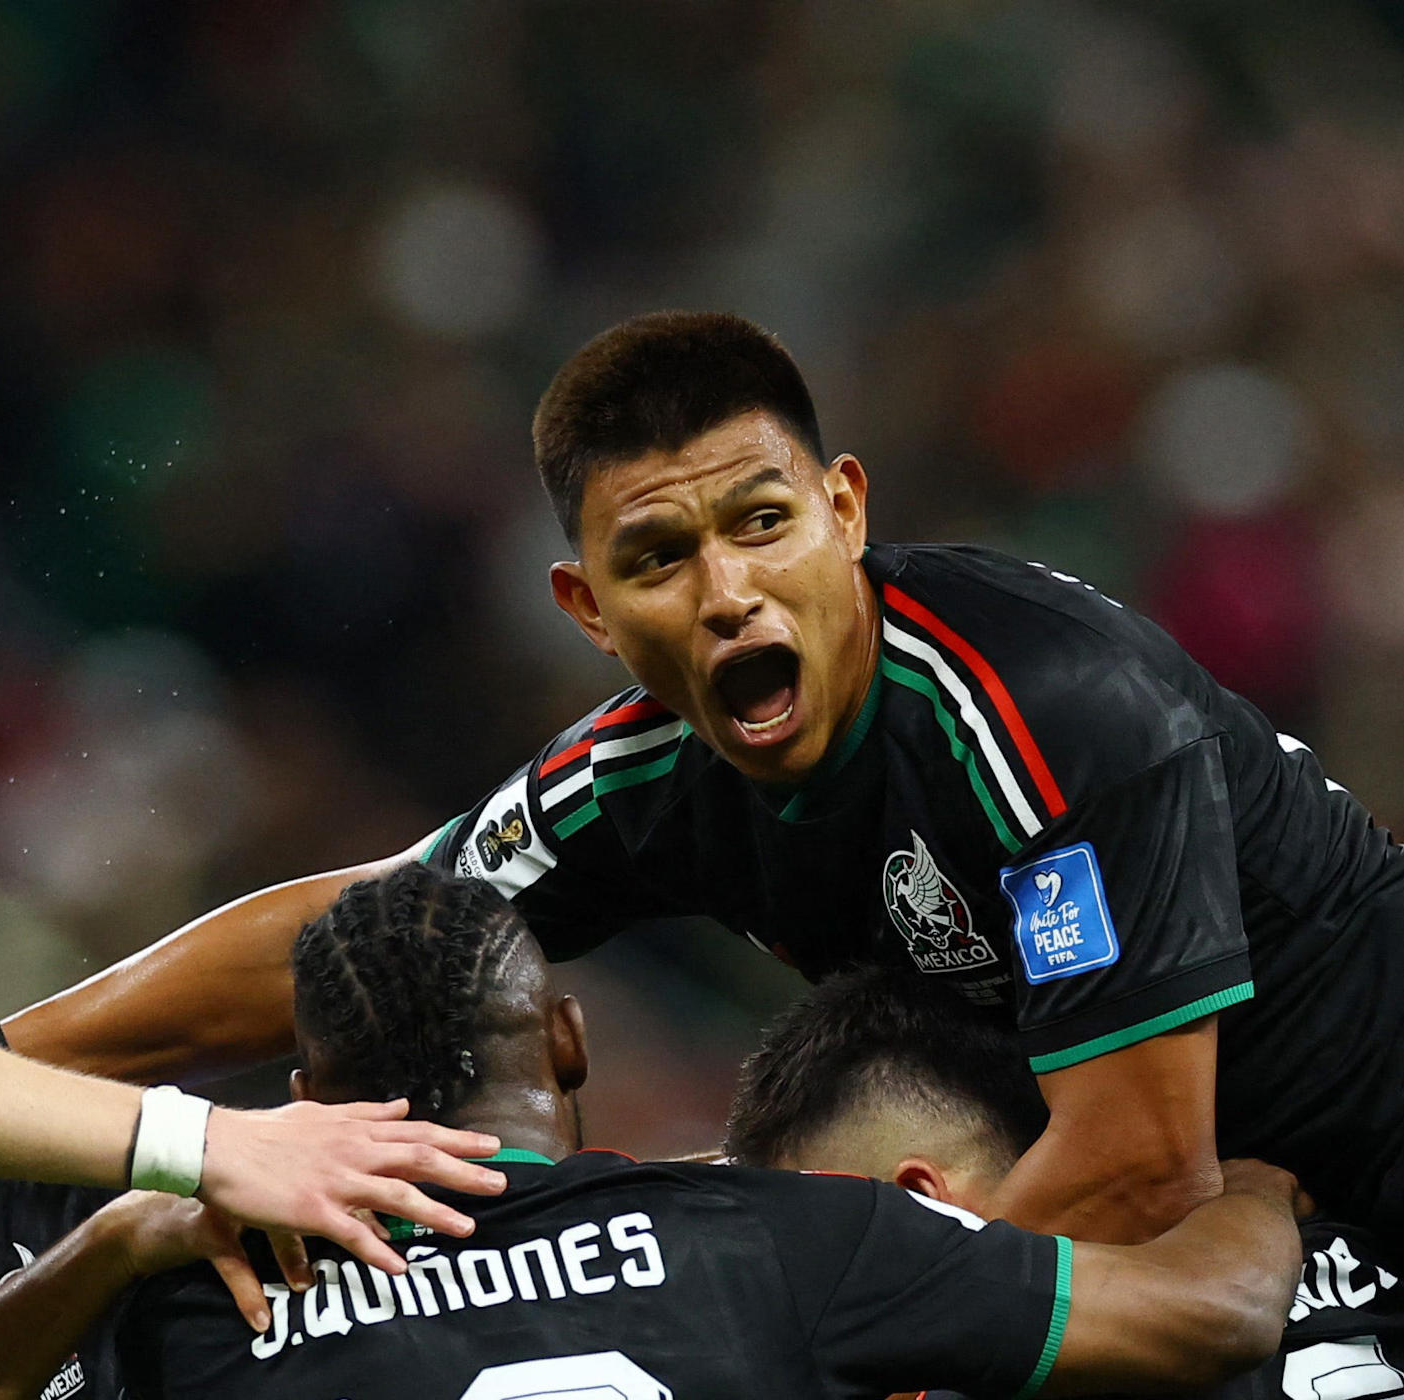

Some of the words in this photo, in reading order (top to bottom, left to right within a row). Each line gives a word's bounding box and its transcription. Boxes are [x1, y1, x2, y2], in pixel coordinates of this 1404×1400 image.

[1029, 910, 1059, 933] Unite
[1057, 901, 1081, 924] For
[1033, 923, 1084, 955] PEACE
[914, 944, 988, 970] MÉXICO
[1047, 951, 1075, 966] FIFA
